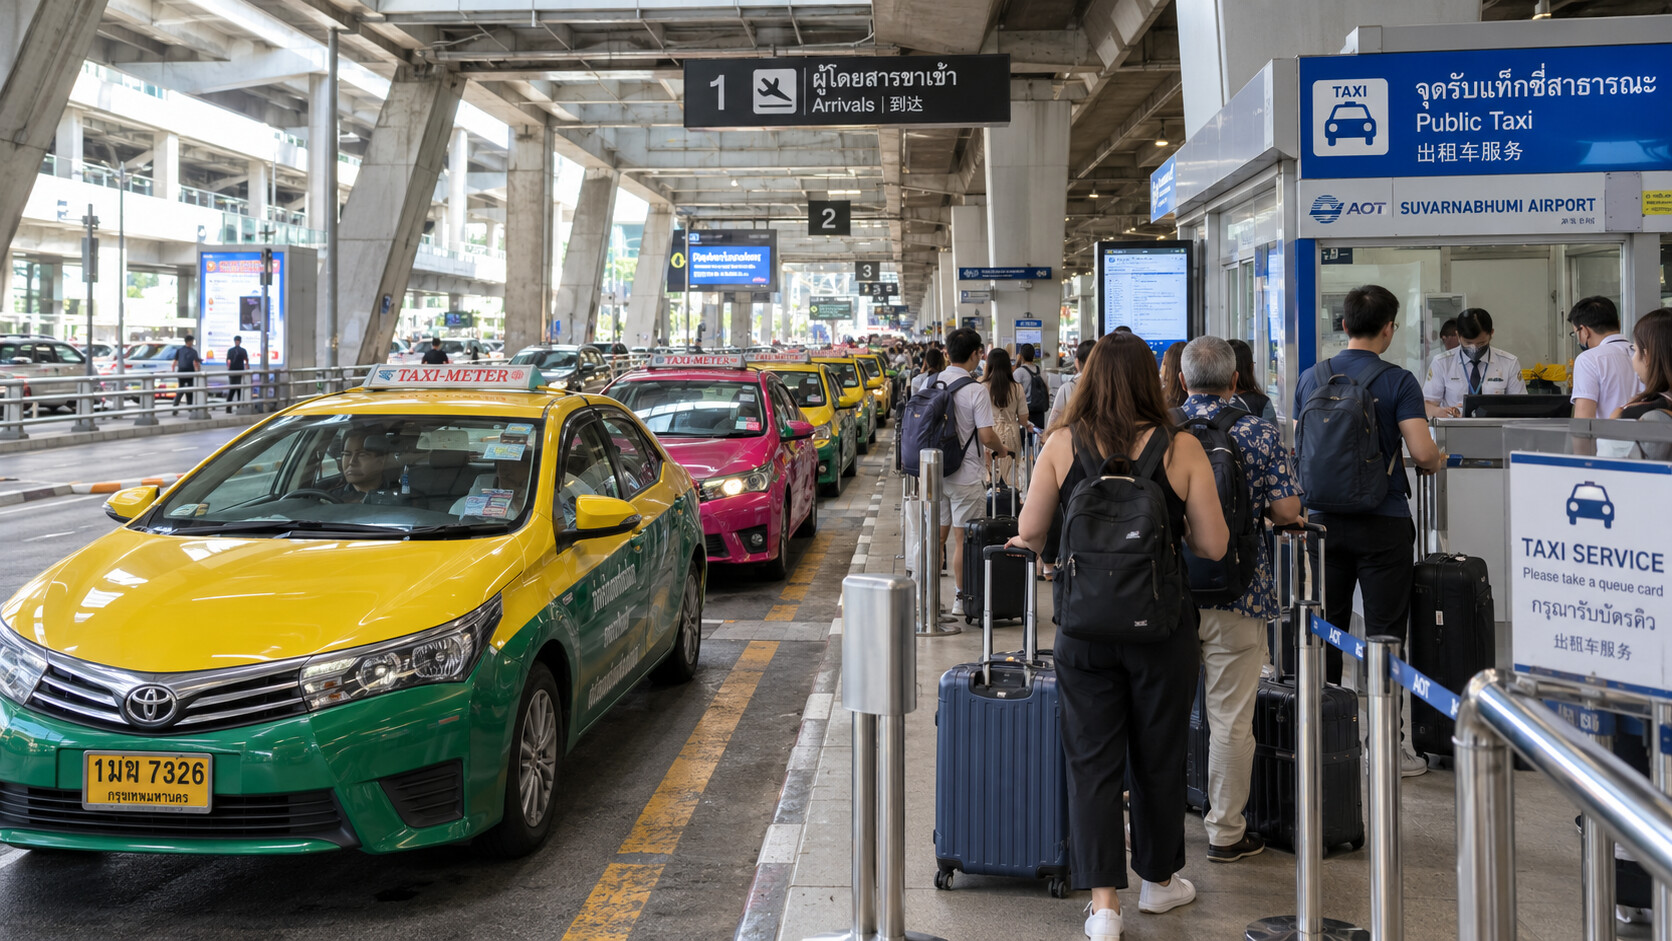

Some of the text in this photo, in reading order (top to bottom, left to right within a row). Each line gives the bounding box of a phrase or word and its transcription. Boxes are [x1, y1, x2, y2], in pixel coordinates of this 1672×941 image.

[812, 61, 957, 95] ผู้โดยสารขาเข้า
[709, 74, 725, 111] 1
[1332, 85, 1368, 98] TAXI
[812, 96, 923, 113] Arrivals 到达
[1416, 110, 1533, 133] Public Taxi
[1417, 140, 1524, 164] 出租车服务
[1346, 201, 1387, 215] AOT
[1400, 198, 1596, 215] SUVARNABHUMI AIRPORT
[821, 208, 836, 229] 2
[862, 264, 872, 278] 3
[397, 369, 509, 382] TAXI-METER
[1521, 538, 1665, 574] TAXI SERVICE
[1523, 567, 1664, 597] Please take a queue card
[1412, 673, 1431, 699] AOT
[148, 760, 205, 785] 7326
